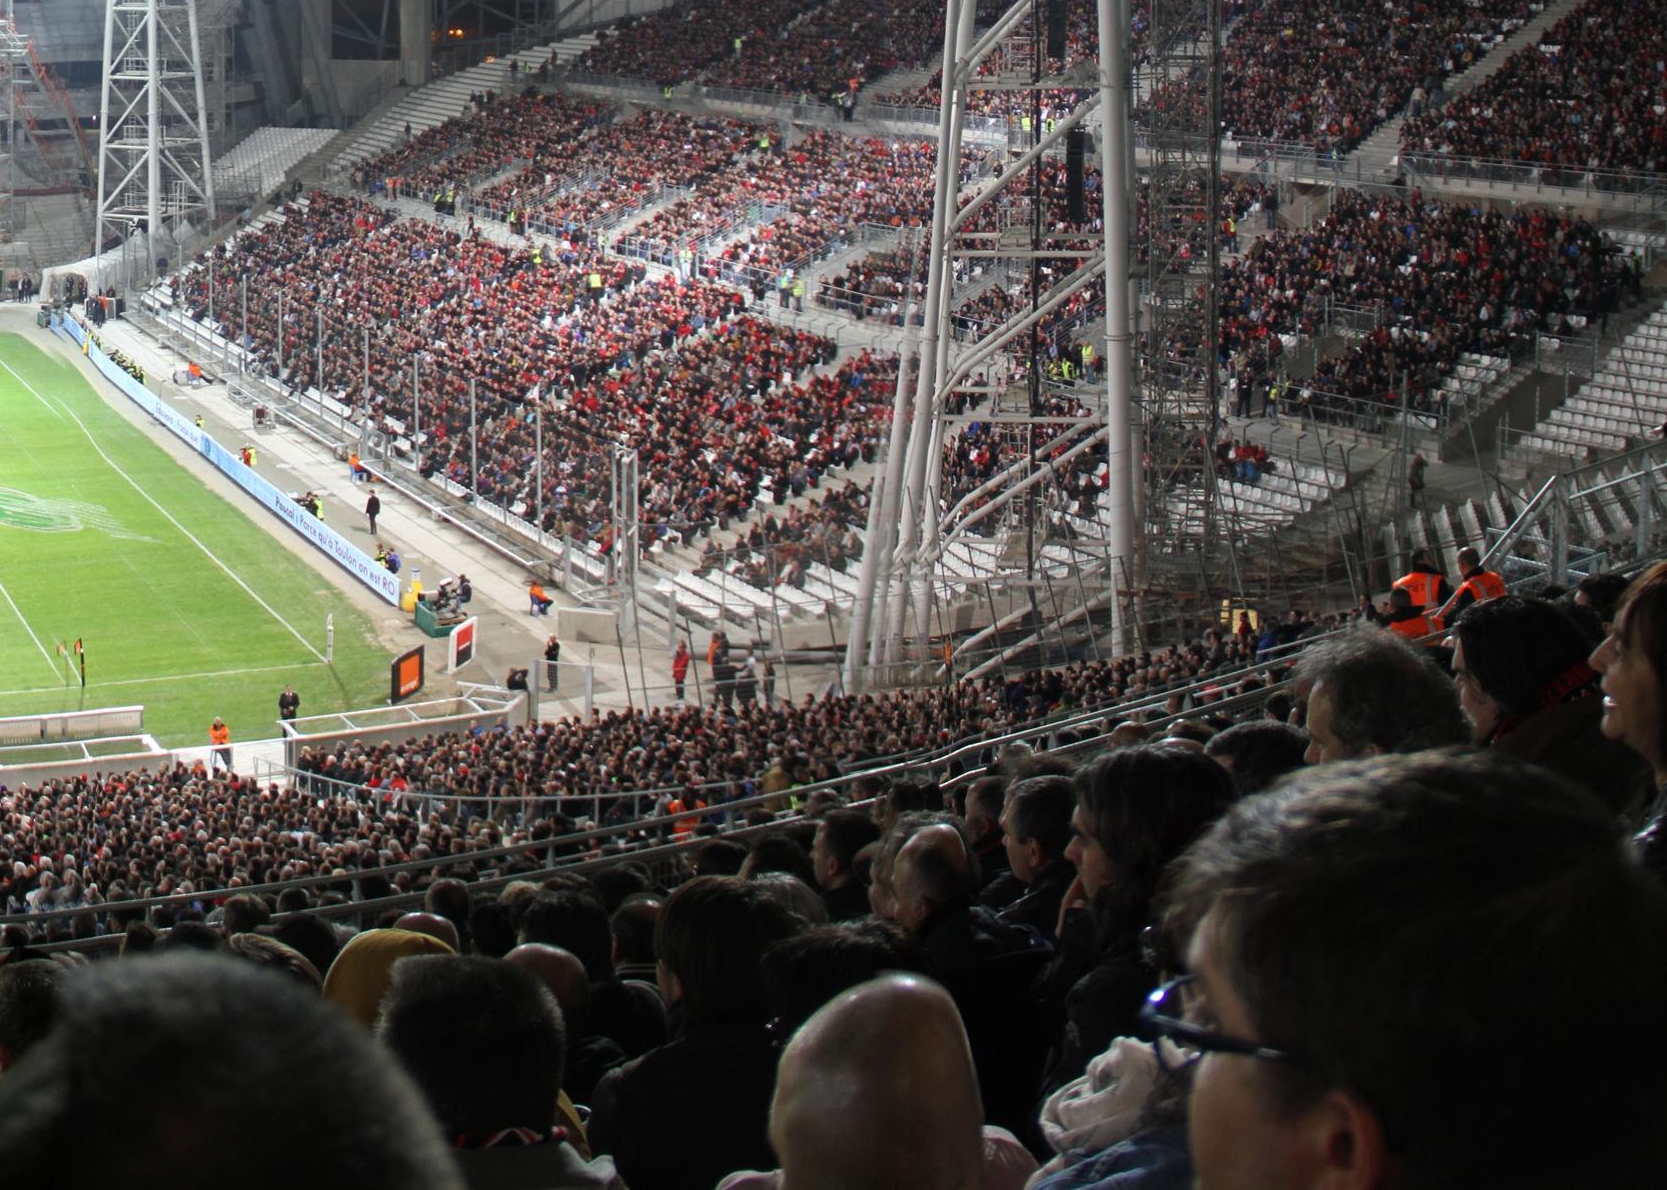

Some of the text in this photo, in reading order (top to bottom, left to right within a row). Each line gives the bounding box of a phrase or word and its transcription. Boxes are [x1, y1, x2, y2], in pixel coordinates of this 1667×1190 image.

[275, 495, 295, 520] Pascal
[299, 514, 317, 537] Parce
[334, 540, 358, 569] Toulon
[358, 562, 368, 576] on
[369, 571, 381, 585] est
[382, 576, 396, 596] RO
